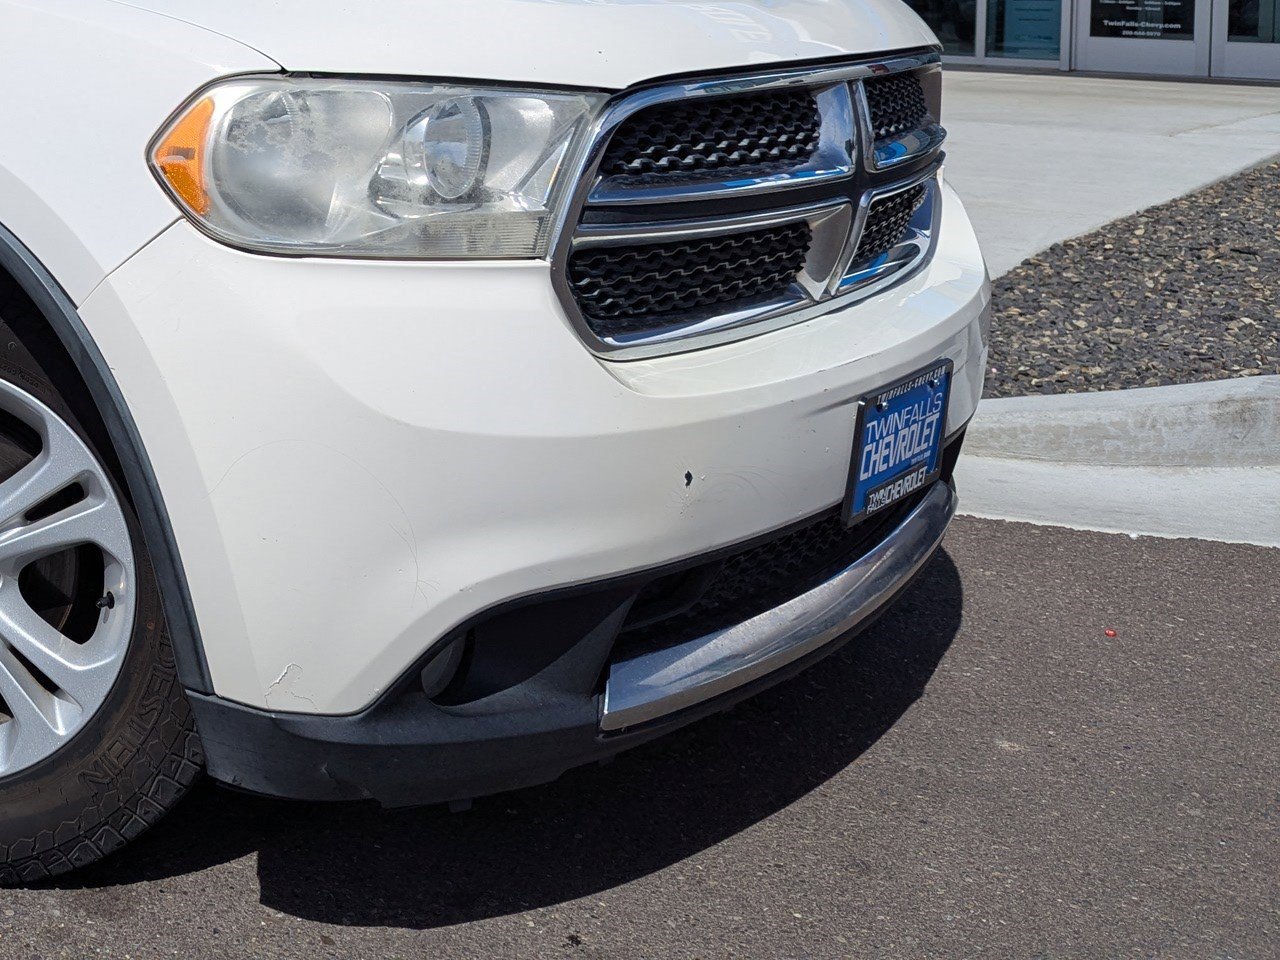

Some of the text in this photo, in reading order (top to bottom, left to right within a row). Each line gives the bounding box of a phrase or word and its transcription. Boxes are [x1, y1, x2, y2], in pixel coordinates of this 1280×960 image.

[866, 392, 942, 443] TWINFALLS
[860, 414, 939, 481] CHEVROLET
[885, 466, 927, 503] CHEVROLET
